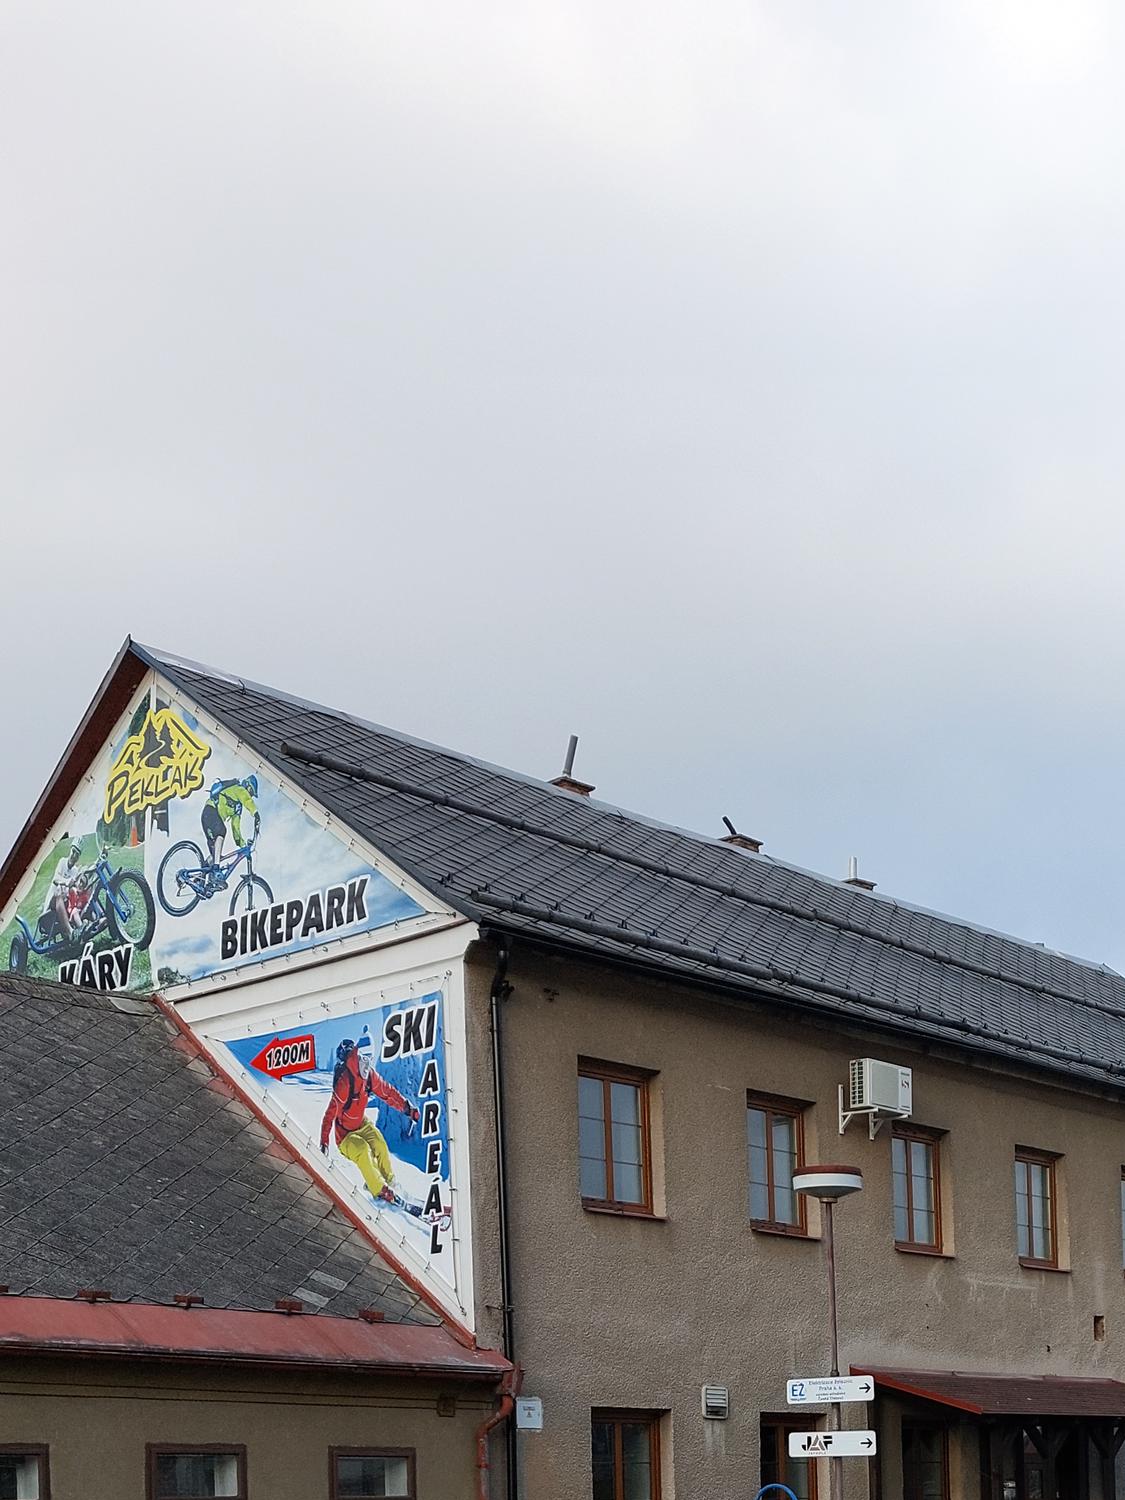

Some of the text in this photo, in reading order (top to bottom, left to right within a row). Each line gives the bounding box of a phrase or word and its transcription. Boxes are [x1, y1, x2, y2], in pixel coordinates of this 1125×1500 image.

[220, 877, 369, 960] BIKEPARK
[266, 1041, 310, 1069] 1200M
[382, 1002, 437, 1060] SKI
[419, 1061, 443, 1254] AREÁL
[801, 1435, 833, 1451] JAF
